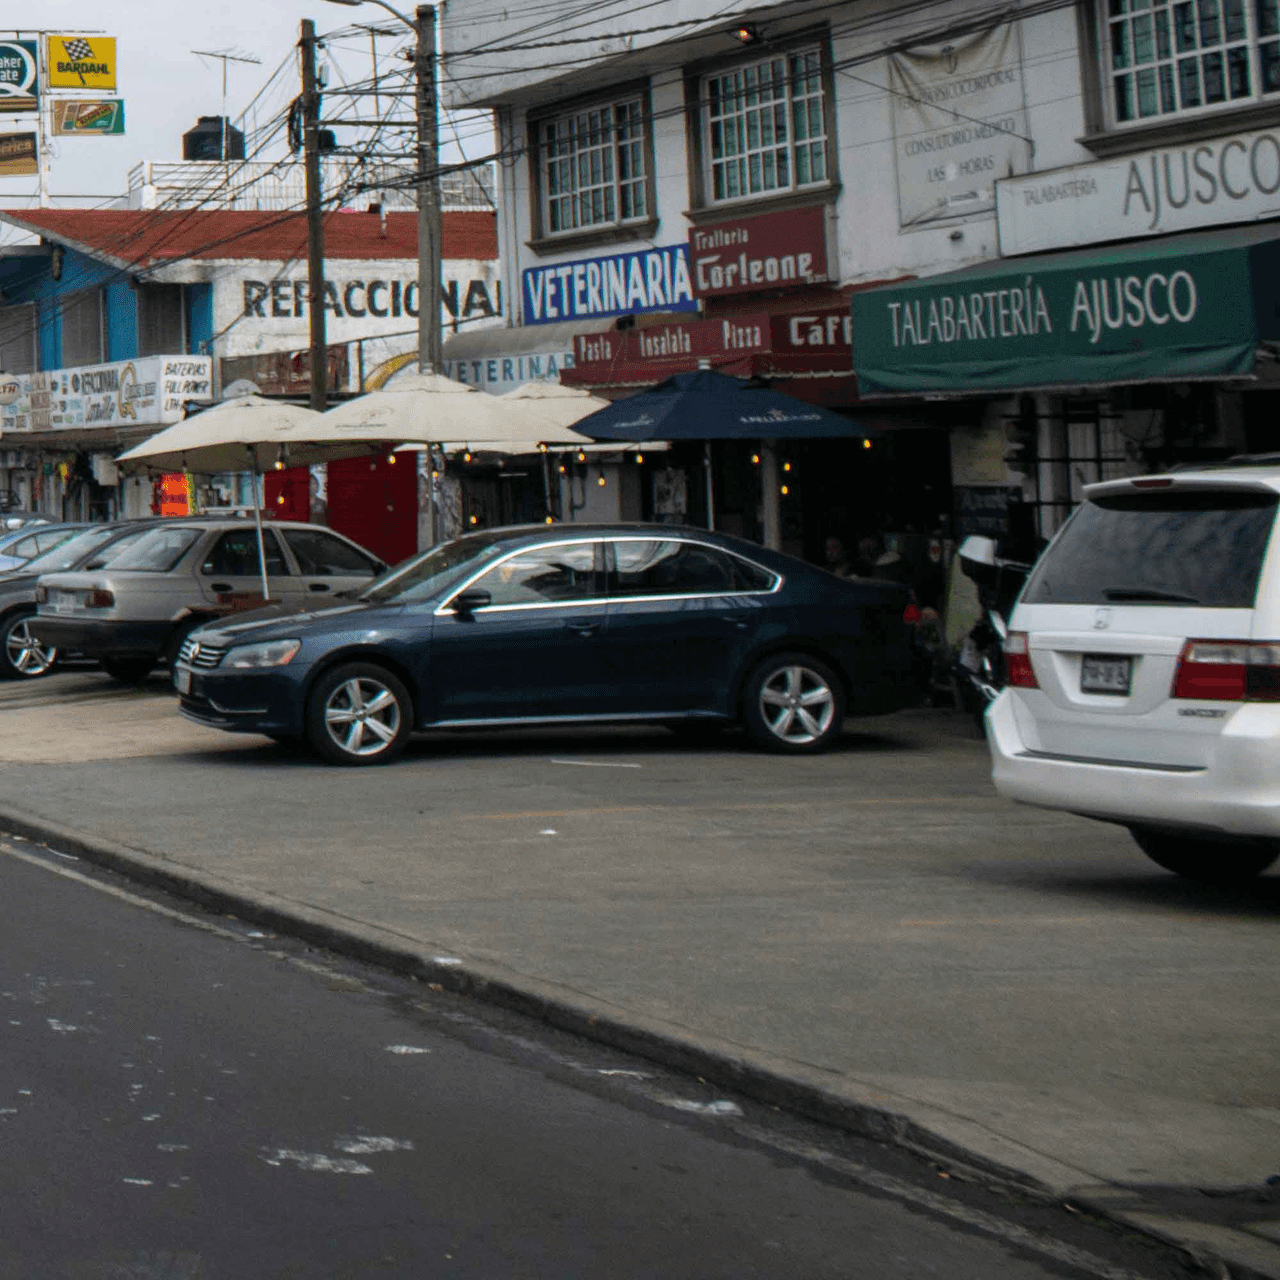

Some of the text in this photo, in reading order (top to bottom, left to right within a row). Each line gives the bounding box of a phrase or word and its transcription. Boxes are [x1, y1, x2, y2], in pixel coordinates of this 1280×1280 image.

[57, 61, 111, 75] BARDAHL
[1124, 133, 1280, 230] AJUSCO
[528, 248, 694, 320] VETERINARIA
[696, 252, 813, 292] Corleone
[888, 270, 1198, 347] TALABARTERÍA AJUSCO
[579, 335, 613, 363] Pasta
[640, 326, 692, 358] Insalata
[723, 319, 762, 350] Pizza
[164, 362, 207, 376] BATERIAS
[165, 380, 182, 394] FULL
